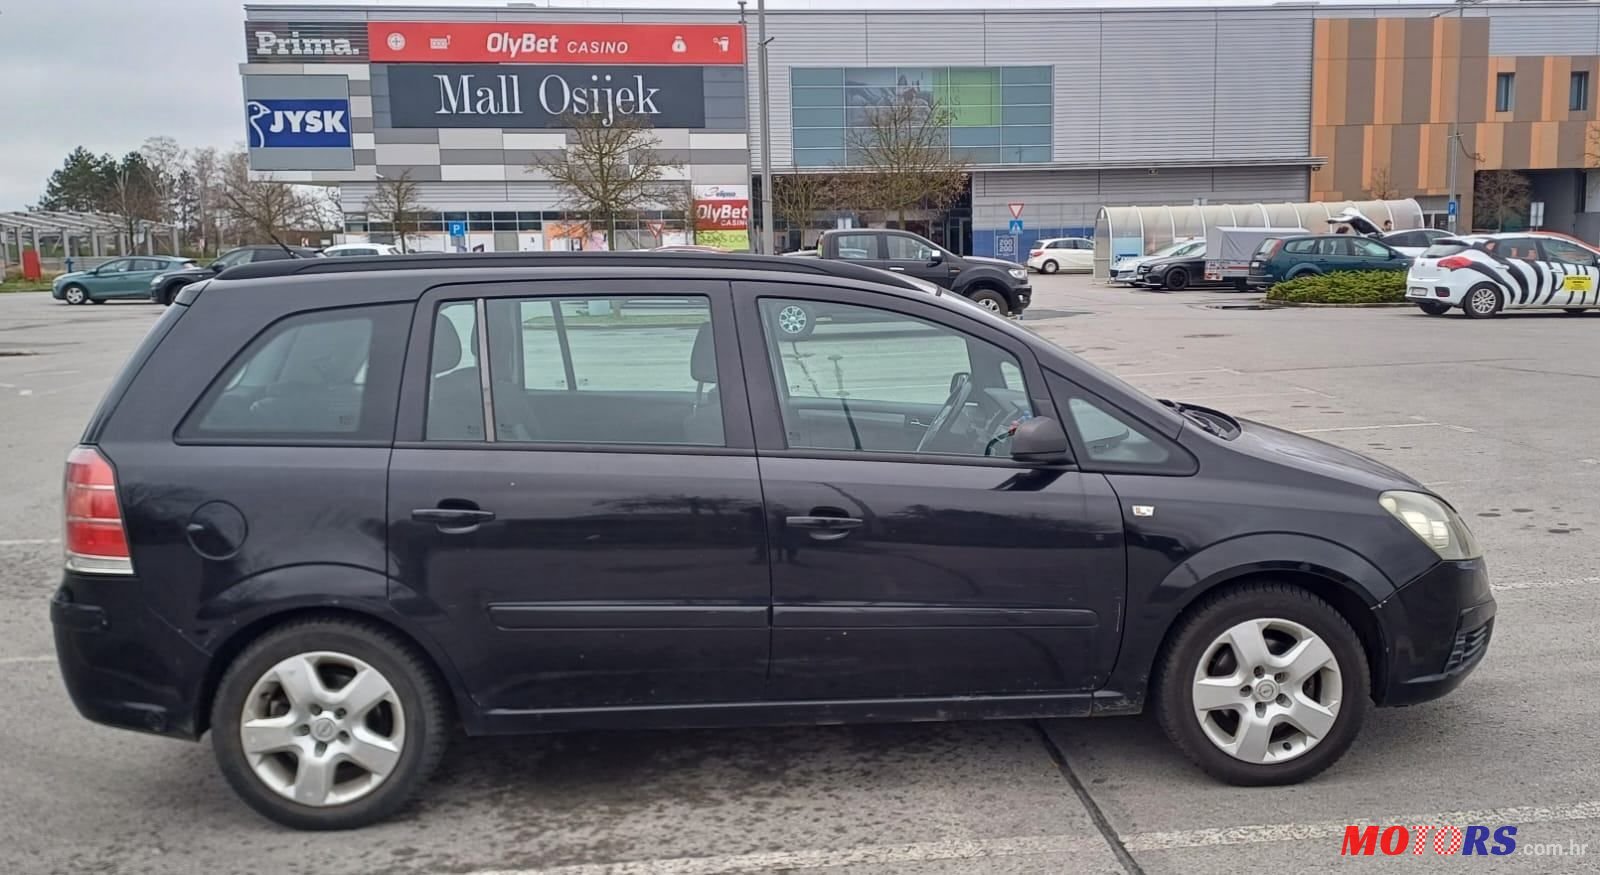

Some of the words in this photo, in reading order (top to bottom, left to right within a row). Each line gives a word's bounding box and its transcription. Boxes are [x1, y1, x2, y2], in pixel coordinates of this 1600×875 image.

[486, 32, 559, 58] OlyBet
[567, 41, 629, 54] CASINO
[432, 74, 524, 115] Mall
[538, 74, 662, 127] Osijek
[269, 110, 347, 133] JYSK
[696, 203, 748, 223] OlyBet
